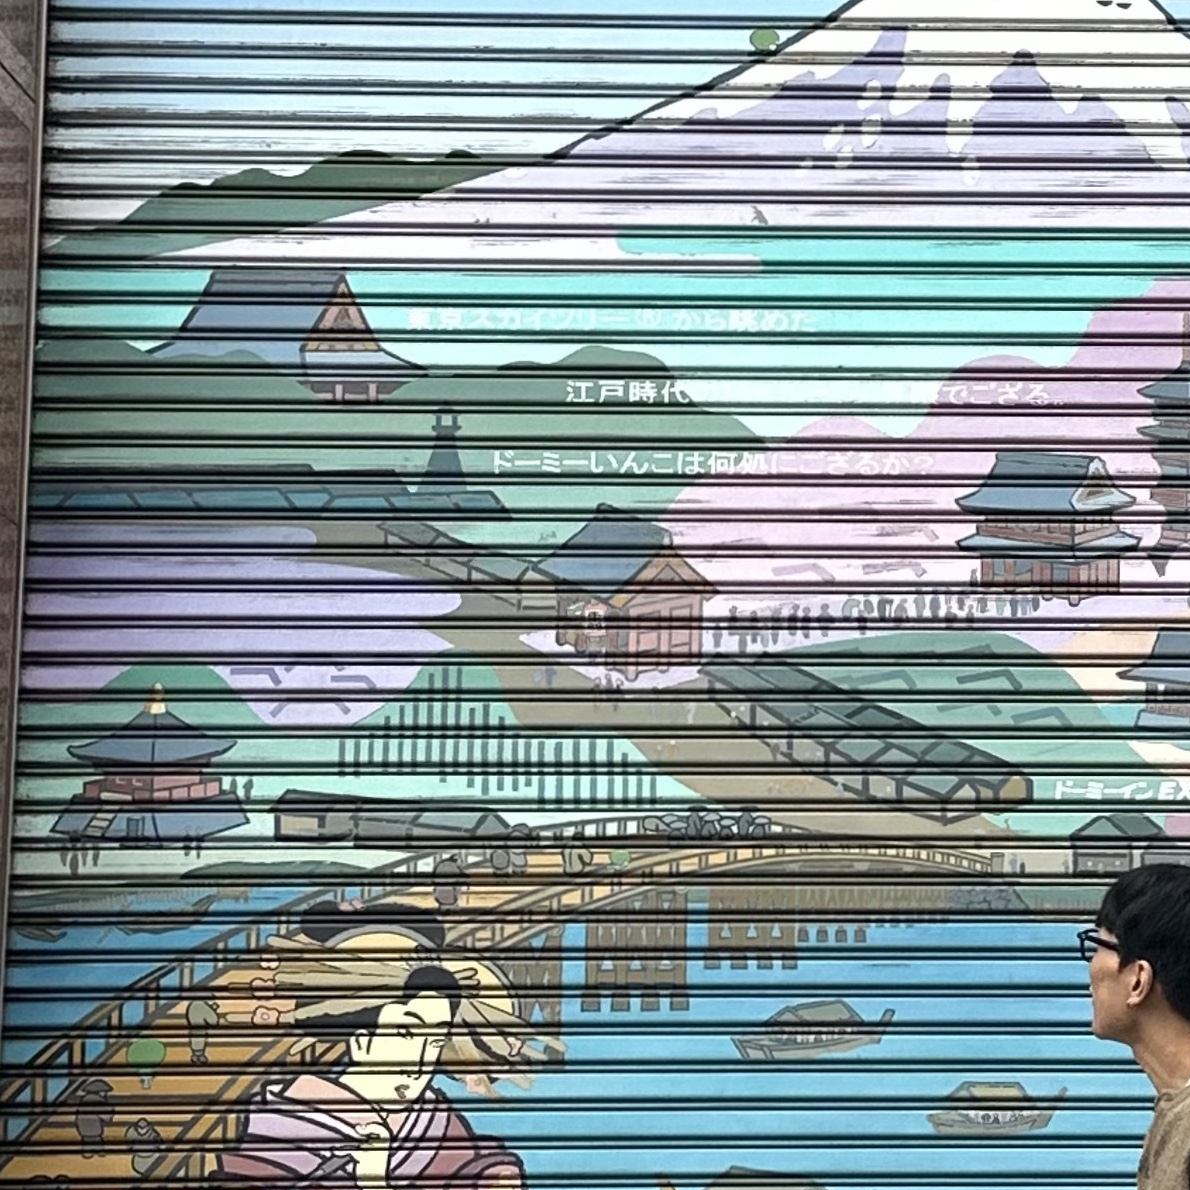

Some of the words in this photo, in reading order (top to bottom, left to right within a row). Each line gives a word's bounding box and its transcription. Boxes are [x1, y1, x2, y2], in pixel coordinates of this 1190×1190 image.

[1054, 780, 1153, 800] ドーミーイン
